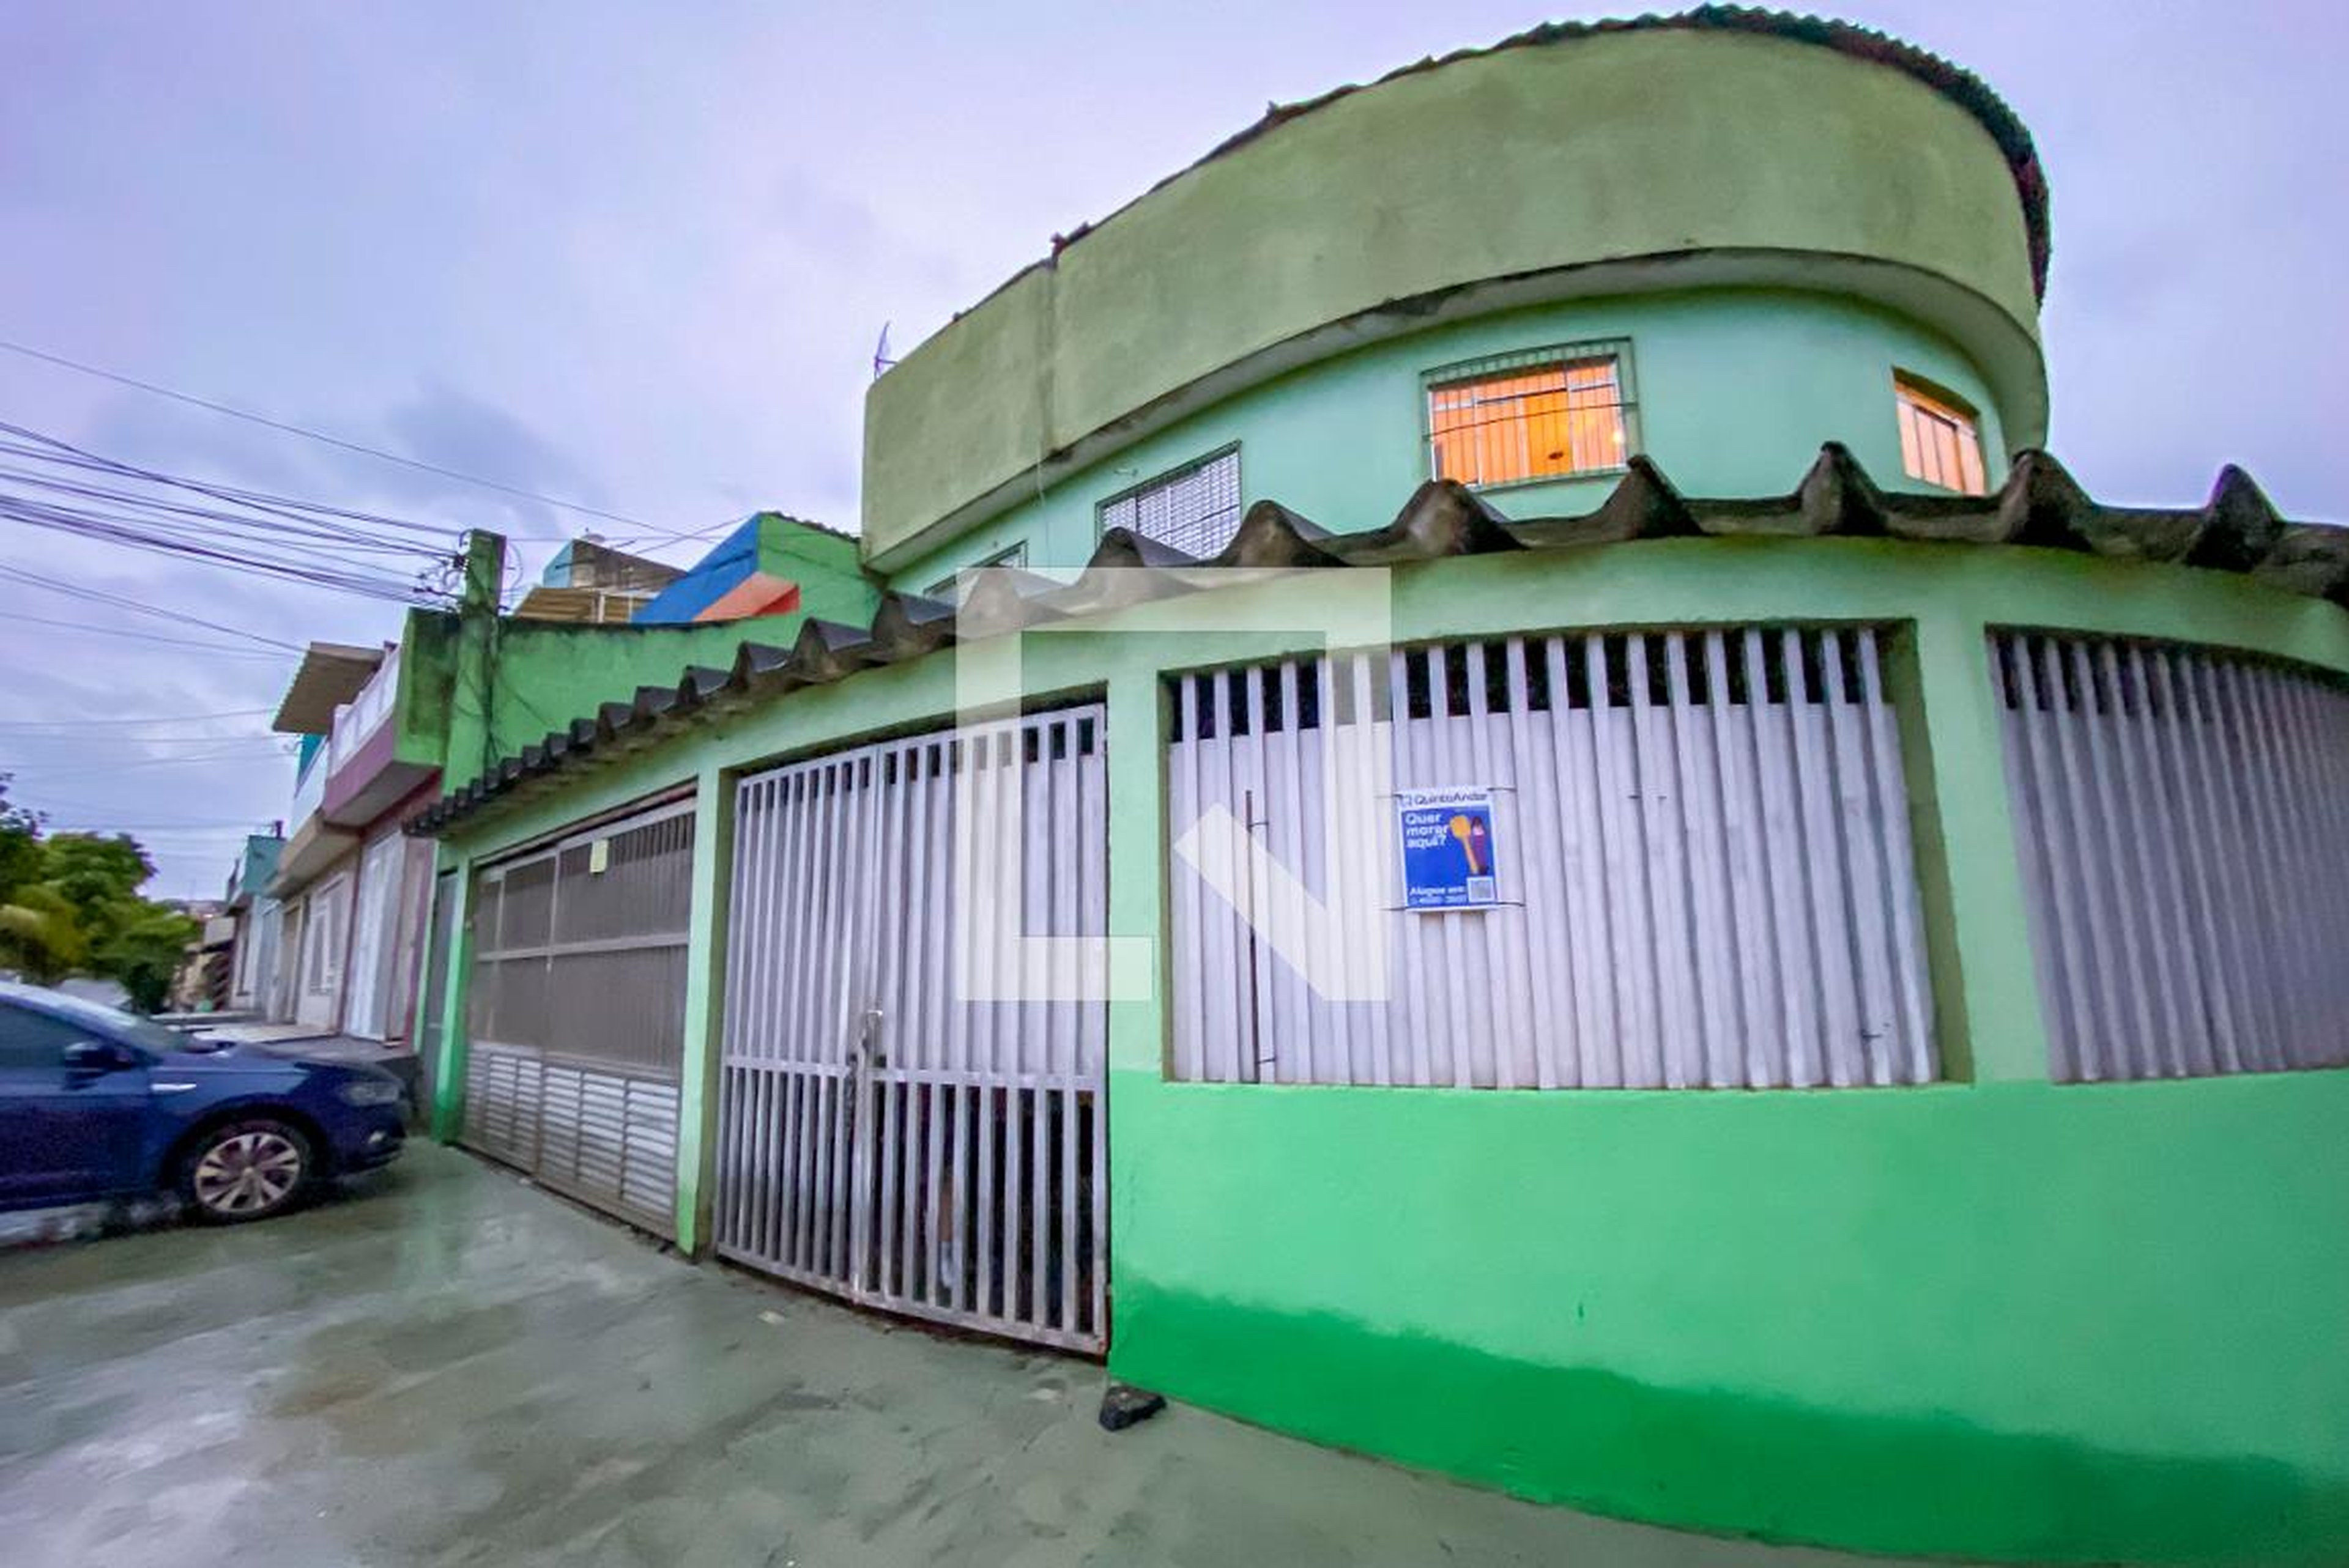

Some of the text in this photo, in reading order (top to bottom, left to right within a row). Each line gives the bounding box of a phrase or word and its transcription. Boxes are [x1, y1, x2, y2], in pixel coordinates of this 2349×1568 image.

[1406, 813, 1441, 824] Quer
[1407, 825, 1448, 836] morar
[1406, 835, 1446, 849] aqui?
